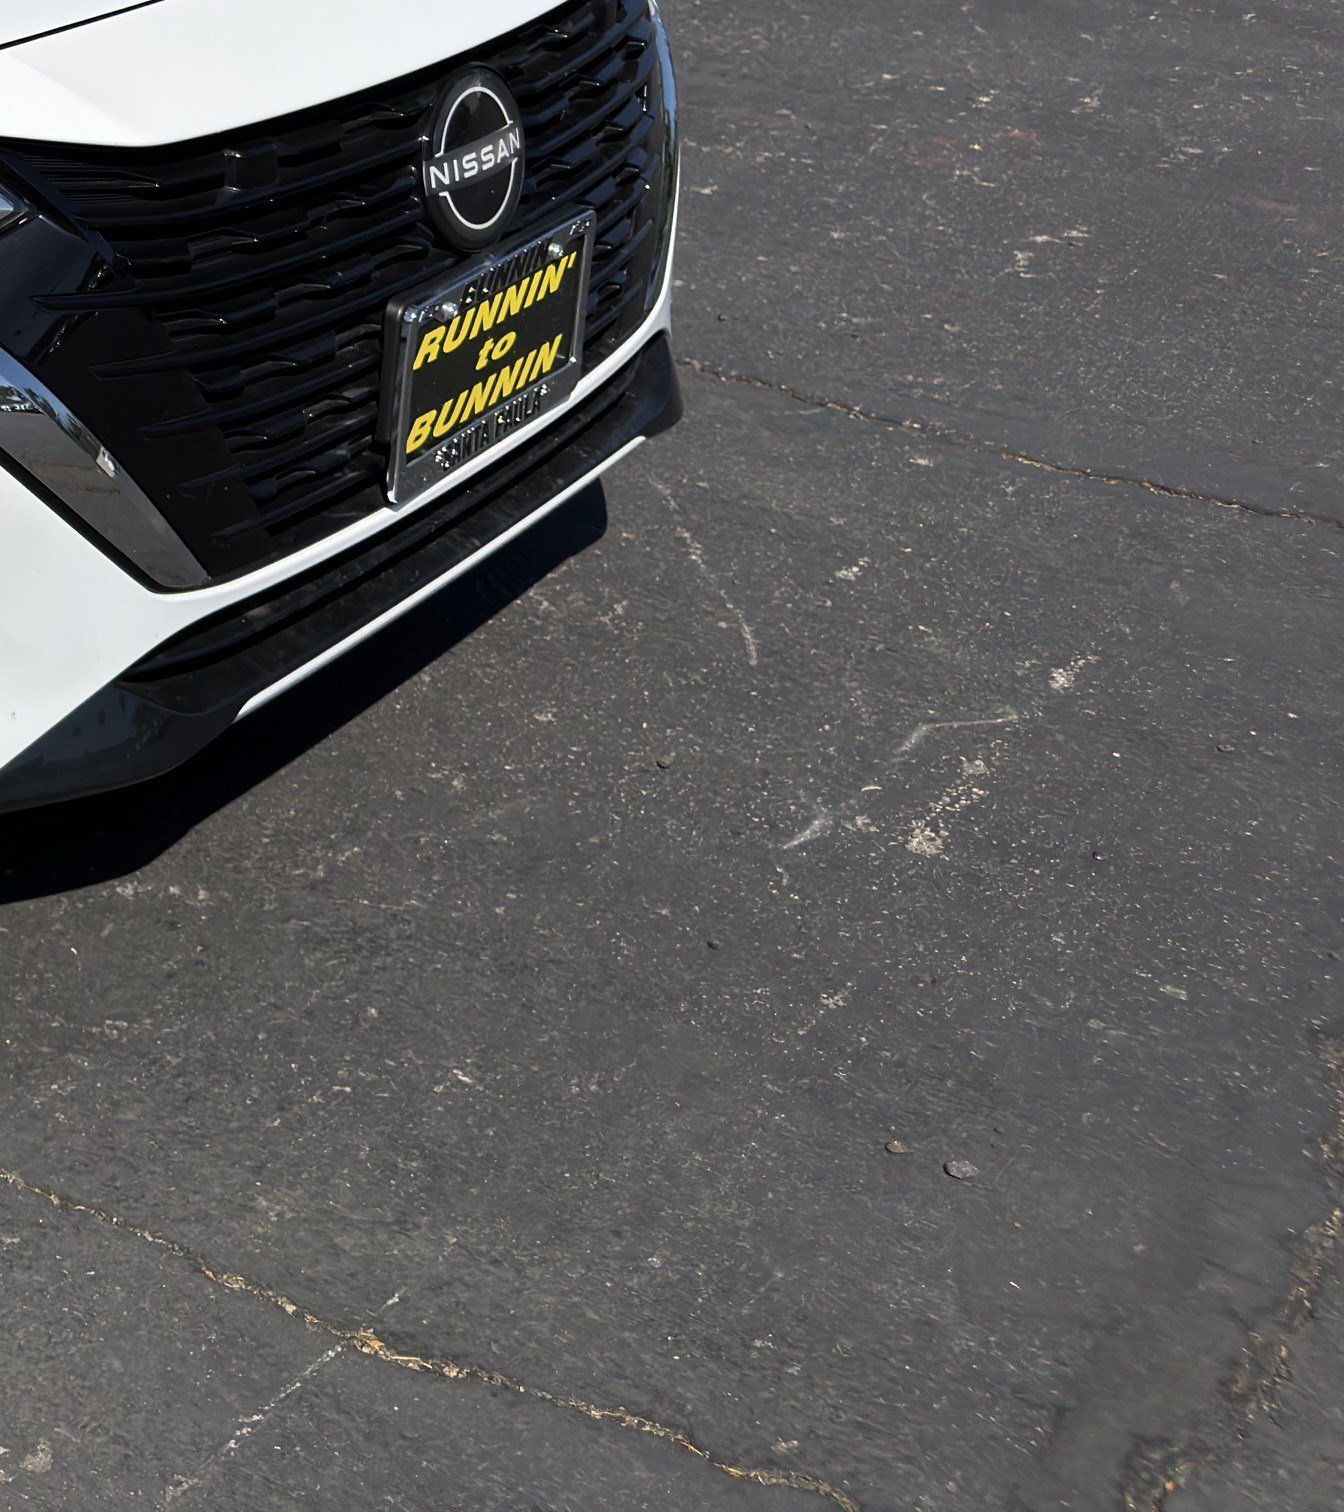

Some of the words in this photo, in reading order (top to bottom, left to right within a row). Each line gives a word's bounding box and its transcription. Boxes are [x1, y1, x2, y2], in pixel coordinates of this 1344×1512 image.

[428, 128, 521, 188] NISSAN
[413, 251, 578, 370] RUNNIN'
[475, 331, 518, 370] to
[406, 334, 564, 454] BUNNIN
